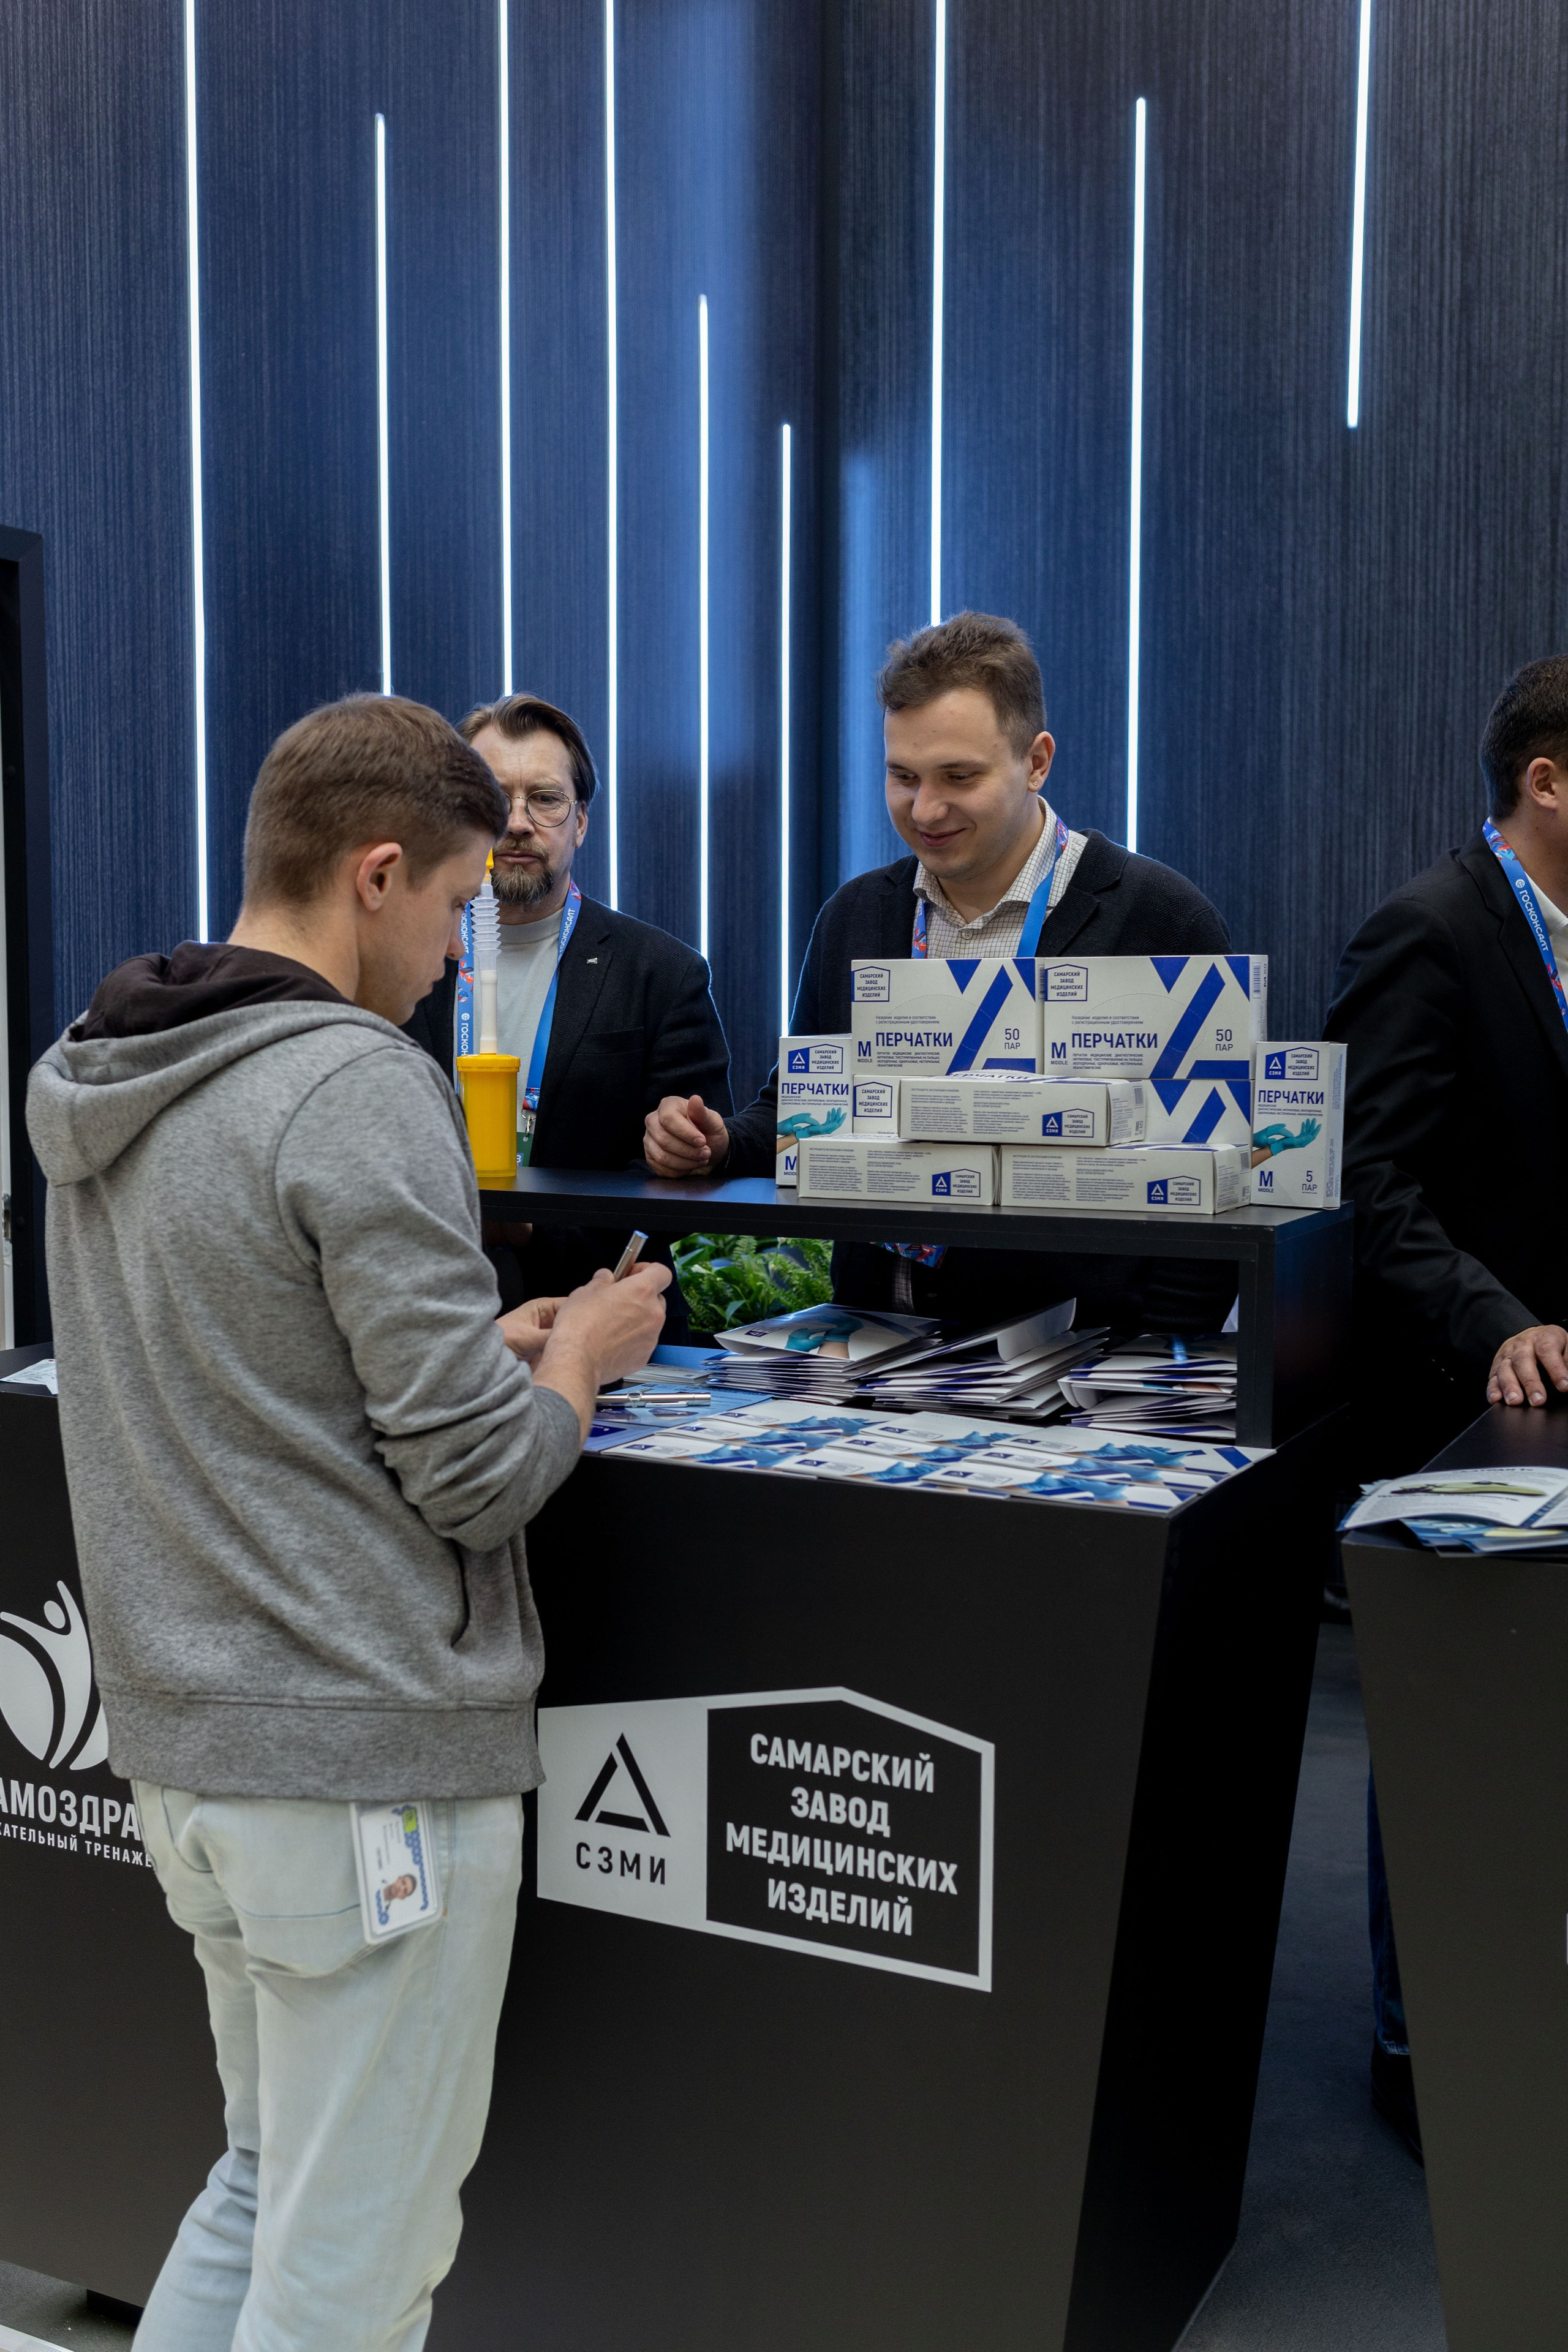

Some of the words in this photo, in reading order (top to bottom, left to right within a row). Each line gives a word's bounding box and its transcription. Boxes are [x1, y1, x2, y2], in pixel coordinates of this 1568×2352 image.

[560, 908, 575, 952] ГОСКОНСАЛТ
[1520, 889, 1548, 951] ГОСКОНСАЛТ
[876, 1032, 952, 1047] ПЕРЧАТКИ
[1005, 1028, 1019, 1040] 50
[1072, 1033, 1158, 1048] ПЕРЧАТКИ
[1216, 1029, 1232, 1041] 50
[782, 1083, 849, 1095] ПЕРЧАТКИ
[1258, 1090, 1324, 1104] ПЕРЧАТКИ
[1306, 1170, 1313, 1182] 5
[750, 1733, 935, 1793] САМАРСКИЙ
[0, 1778, 141, 1841] МОЗДРА
[791, 1786, 891, 1838] ЗАВОД
[0, 1822, 77, 1852] АТЕЛЬНЫЙ
[85, 1840, 152, 1868] ТРЕНАЖЕ
[576, 1842, 666, 1885] СЗМИ
[726, 1822, 958, 1895] МЕДИЦИНСКИХ
[767, 1878, 913, 1936] ИЗДЕЛИЙ
